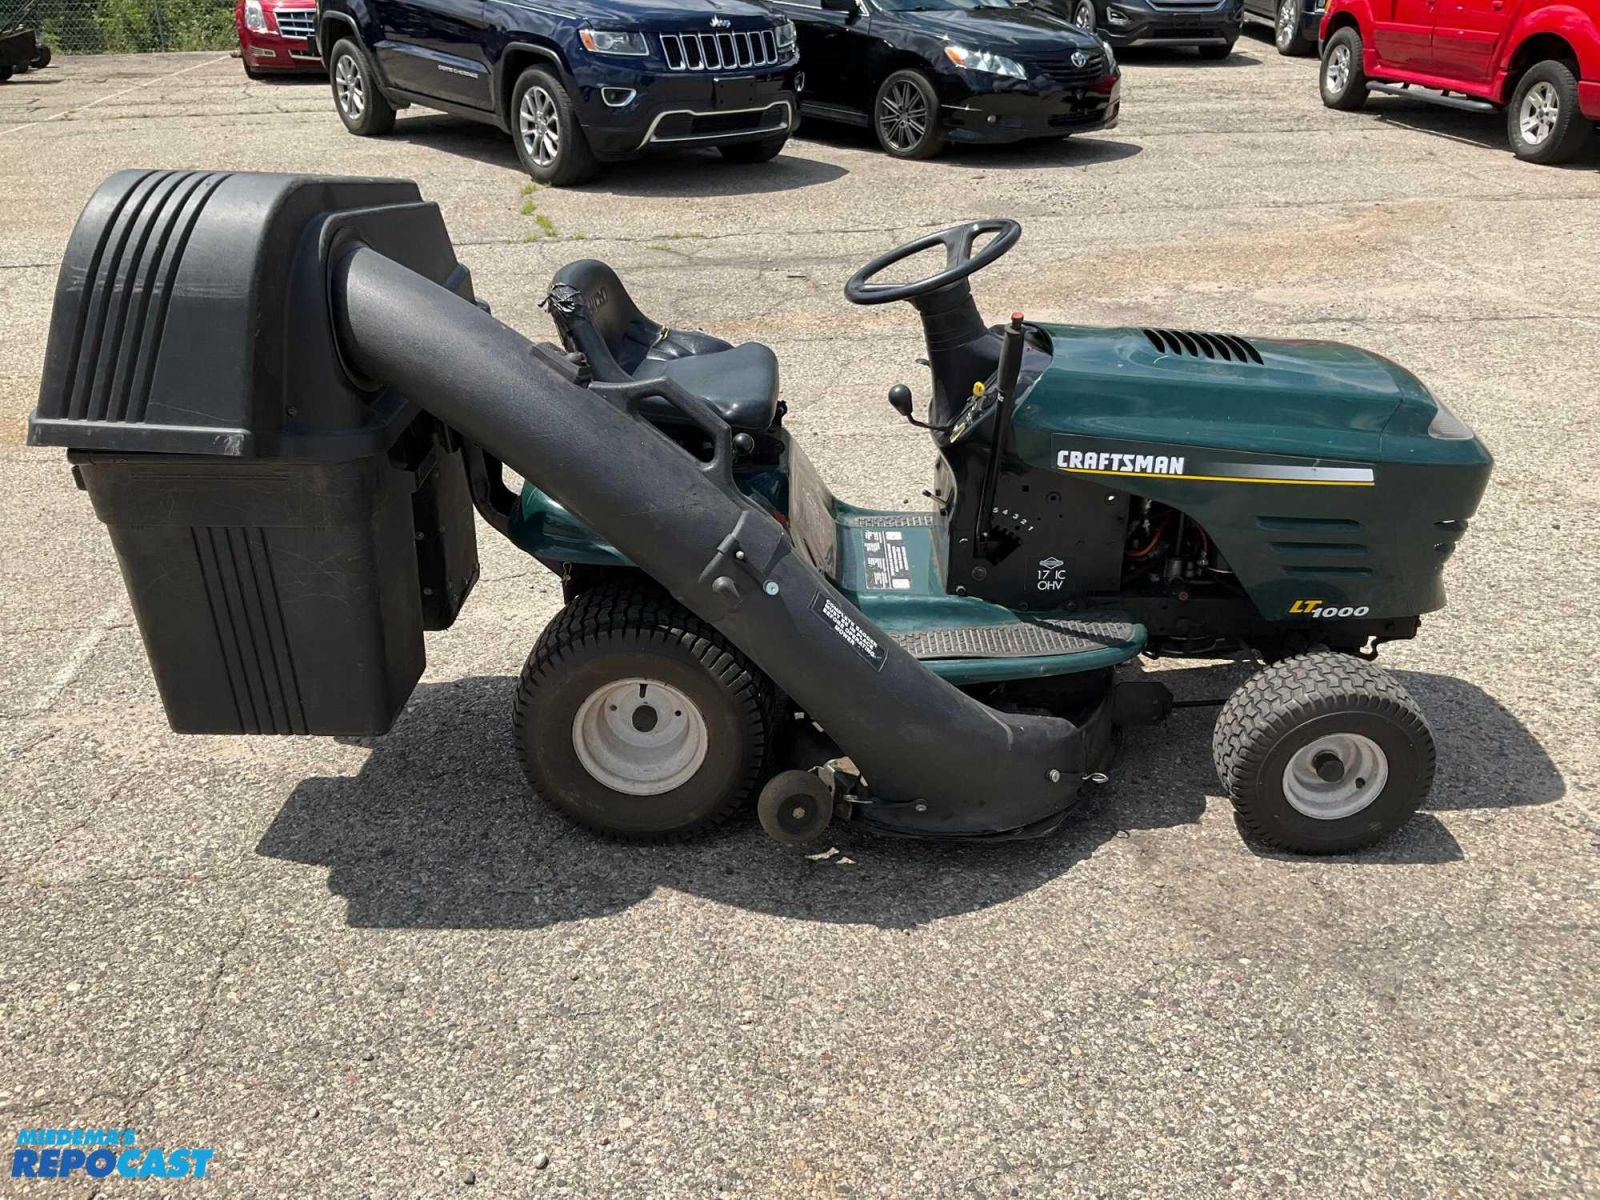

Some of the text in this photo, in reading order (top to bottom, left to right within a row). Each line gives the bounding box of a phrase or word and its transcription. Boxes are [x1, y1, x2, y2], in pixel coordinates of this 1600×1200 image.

[1057, 450, 1185, 475] CRAFTSMAN
[1037, 570, 1050, 580] 17
[1037, 580, 1063, 590] OHV
[1288, 600, 1370, 618] LT 1000
[822, 607, 876, 657] BEFORE OPERATING
[825, 603, 841, 618] MUST
[856, 632, 874, 650] PLACE
[826, 599, 878, 648] COMPLETE BAGGER
[834, 624, 855, 646] MOWER
